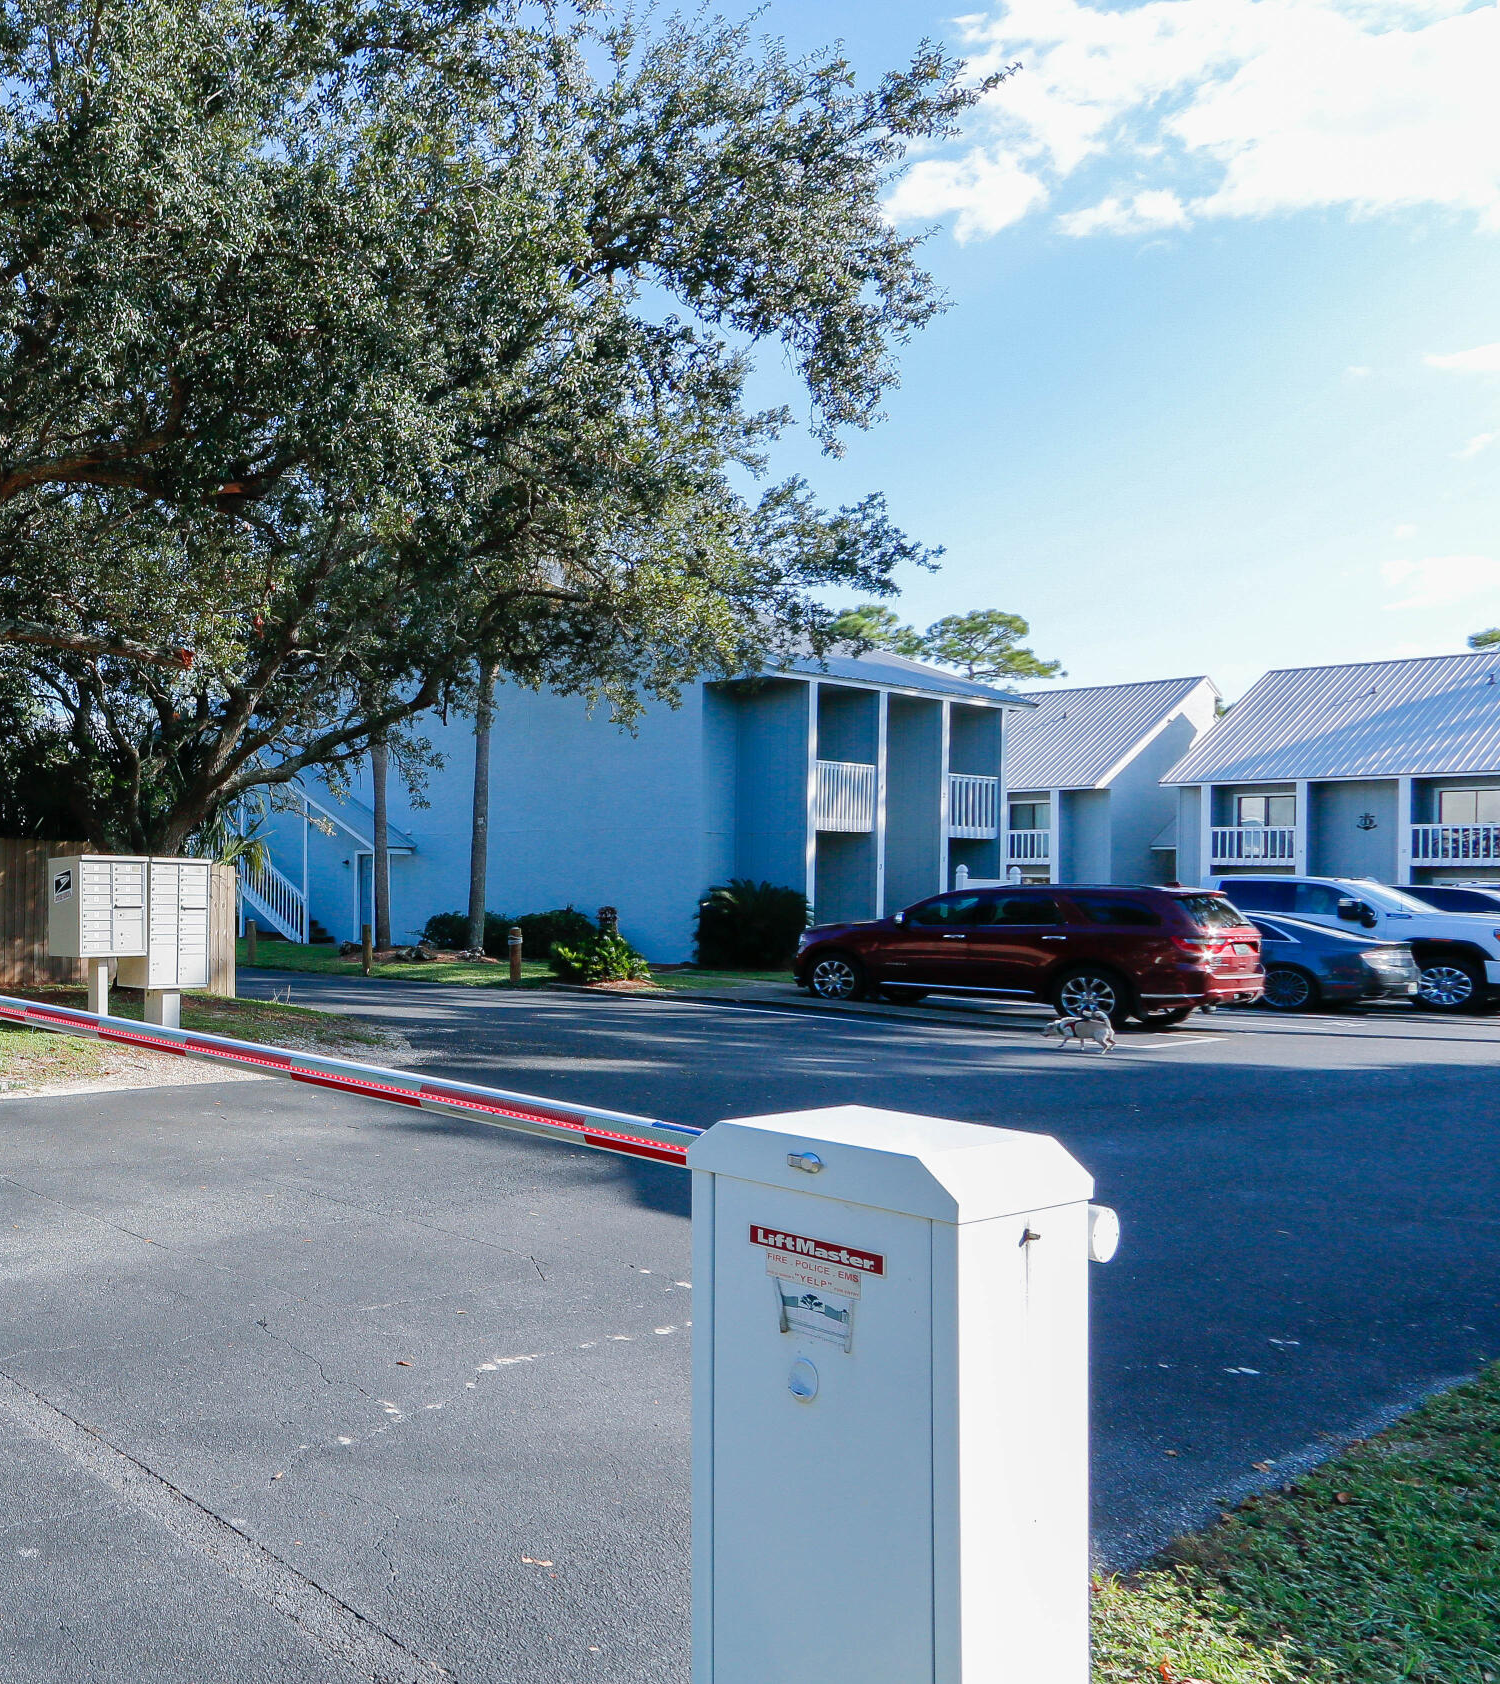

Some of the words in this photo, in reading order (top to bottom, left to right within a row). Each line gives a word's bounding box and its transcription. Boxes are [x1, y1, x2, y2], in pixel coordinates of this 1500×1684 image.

[757, 1228, 875, 1270] LiftMaster
[766, 1252, 788, 1264] FIRE
[795, 1259, 830, 1275] POLICE
[837, 1270, 859, 1283] EMS
